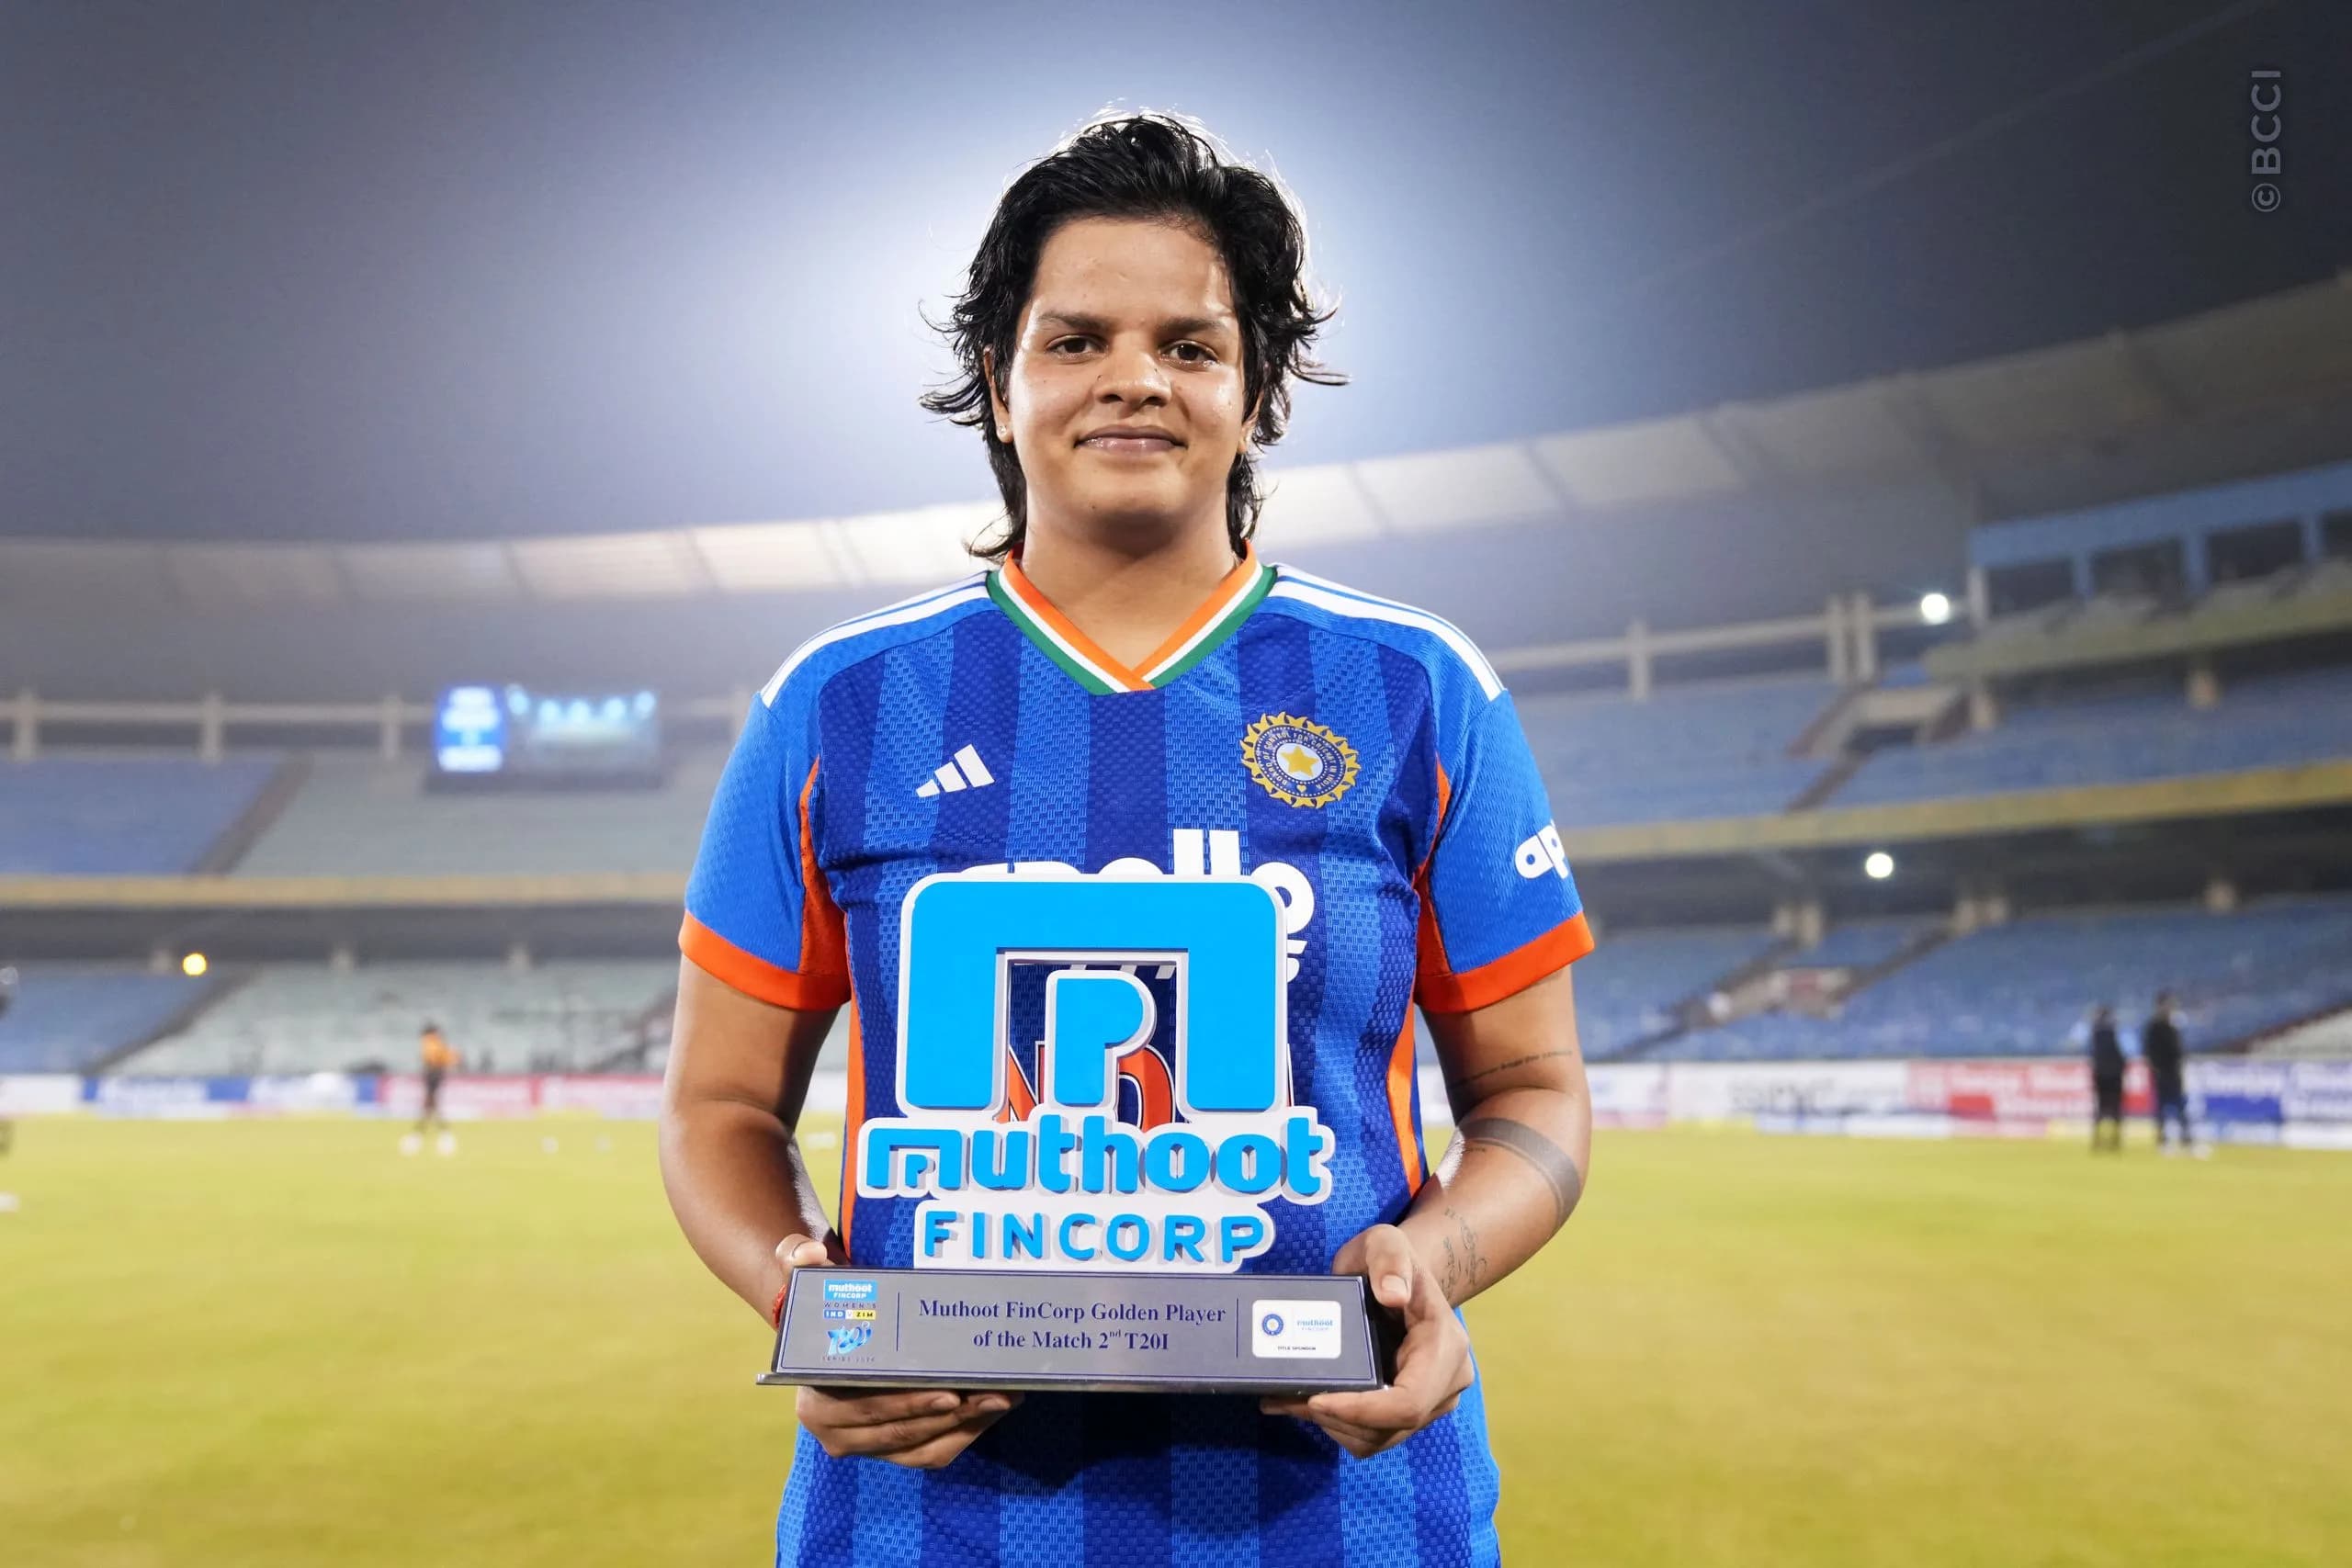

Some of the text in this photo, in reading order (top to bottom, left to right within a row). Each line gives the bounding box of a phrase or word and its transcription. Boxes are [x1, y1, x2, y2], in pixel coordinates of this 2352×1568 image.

[866, 1114, 1323, 1194] muthoot
[924, 1210, 1265, 1264] FINCORP
[828, 1283, 873, 1292] muthoot
[919, 1300, 1227, 1325] Muthoot FinCorp Golden Player
[973, 1330, 993, 1347] of
[997, 1330, 1025, 1347] the
[1033, 1331, 1091, 1348] Match
[1125, 1333, 1170, 1349] T20I
